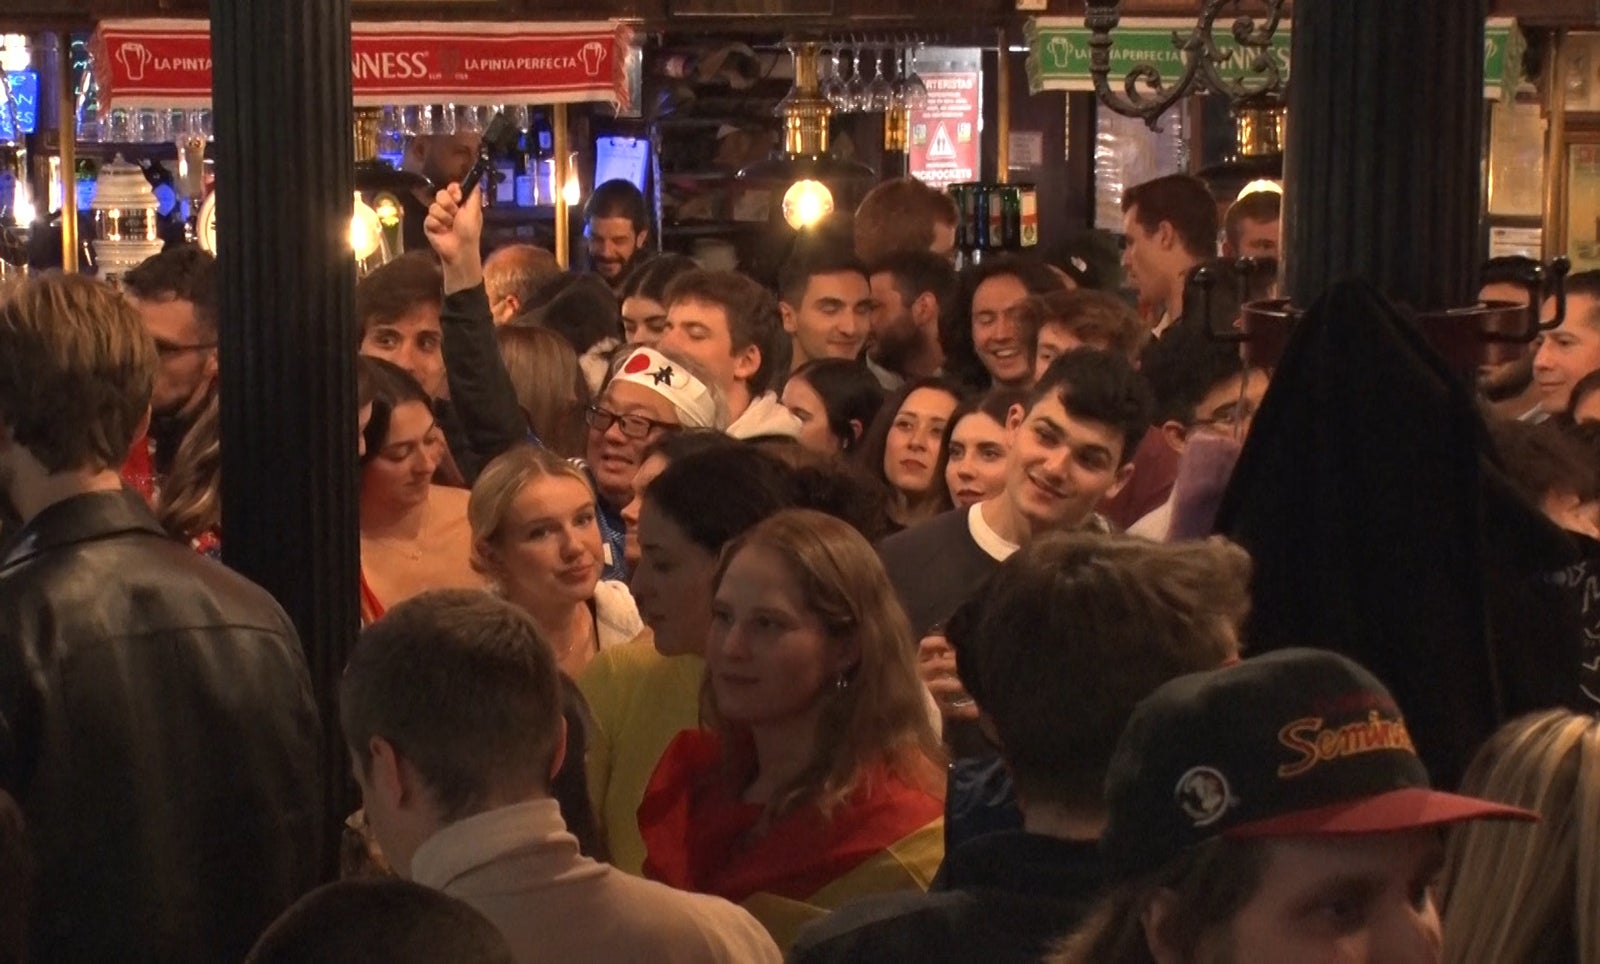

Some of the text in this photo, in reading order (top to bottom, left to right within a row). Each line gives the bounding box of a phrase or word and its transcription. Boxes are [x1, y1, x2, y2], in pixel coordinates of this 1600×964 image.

[1075, 49, 1087, 60] LA
[1122, 48, 1180, 61] PERFECTA
[154, 58, 212, 70] LA PINTA
[464, 56, 577, 71] LA PINTA PERFECTA
